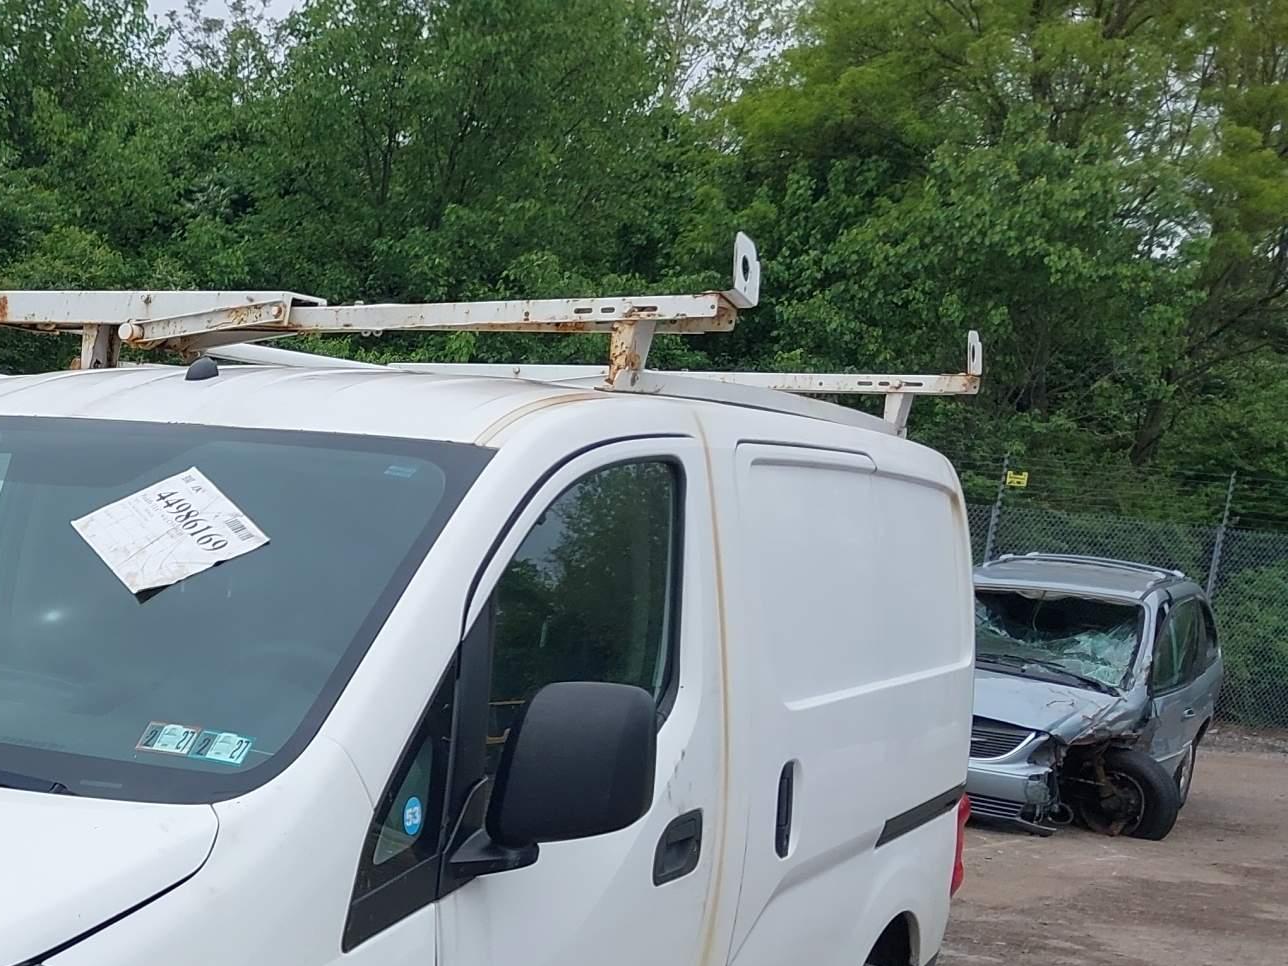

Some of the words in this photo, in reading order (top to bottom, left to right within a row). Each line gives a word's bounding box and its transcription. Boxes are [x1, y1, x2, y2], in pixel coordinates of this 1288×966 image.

[156, 491, 228, 551] 44986169
[176, 731, 196, 752] 27
[229, 739, 250, 762] 27
